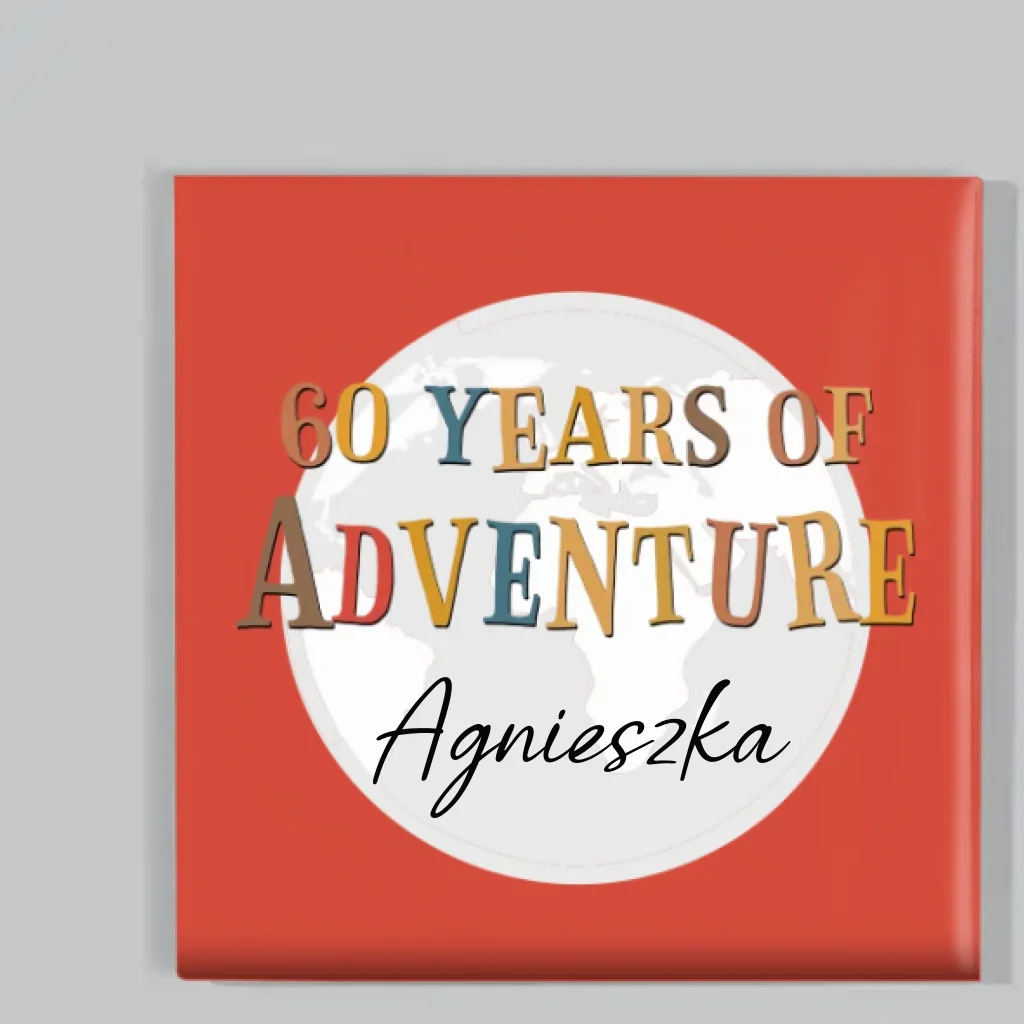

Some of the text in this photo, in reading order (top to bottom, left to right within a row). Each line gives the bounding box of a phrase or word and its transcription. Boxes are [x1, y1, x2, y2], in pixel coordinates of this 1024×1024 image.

[280, 381, 874, 473] 60 YEARS OF
[237, 496, 918, 638] ADVENTURE
[372, 676, 791, 819] Agnieszka
